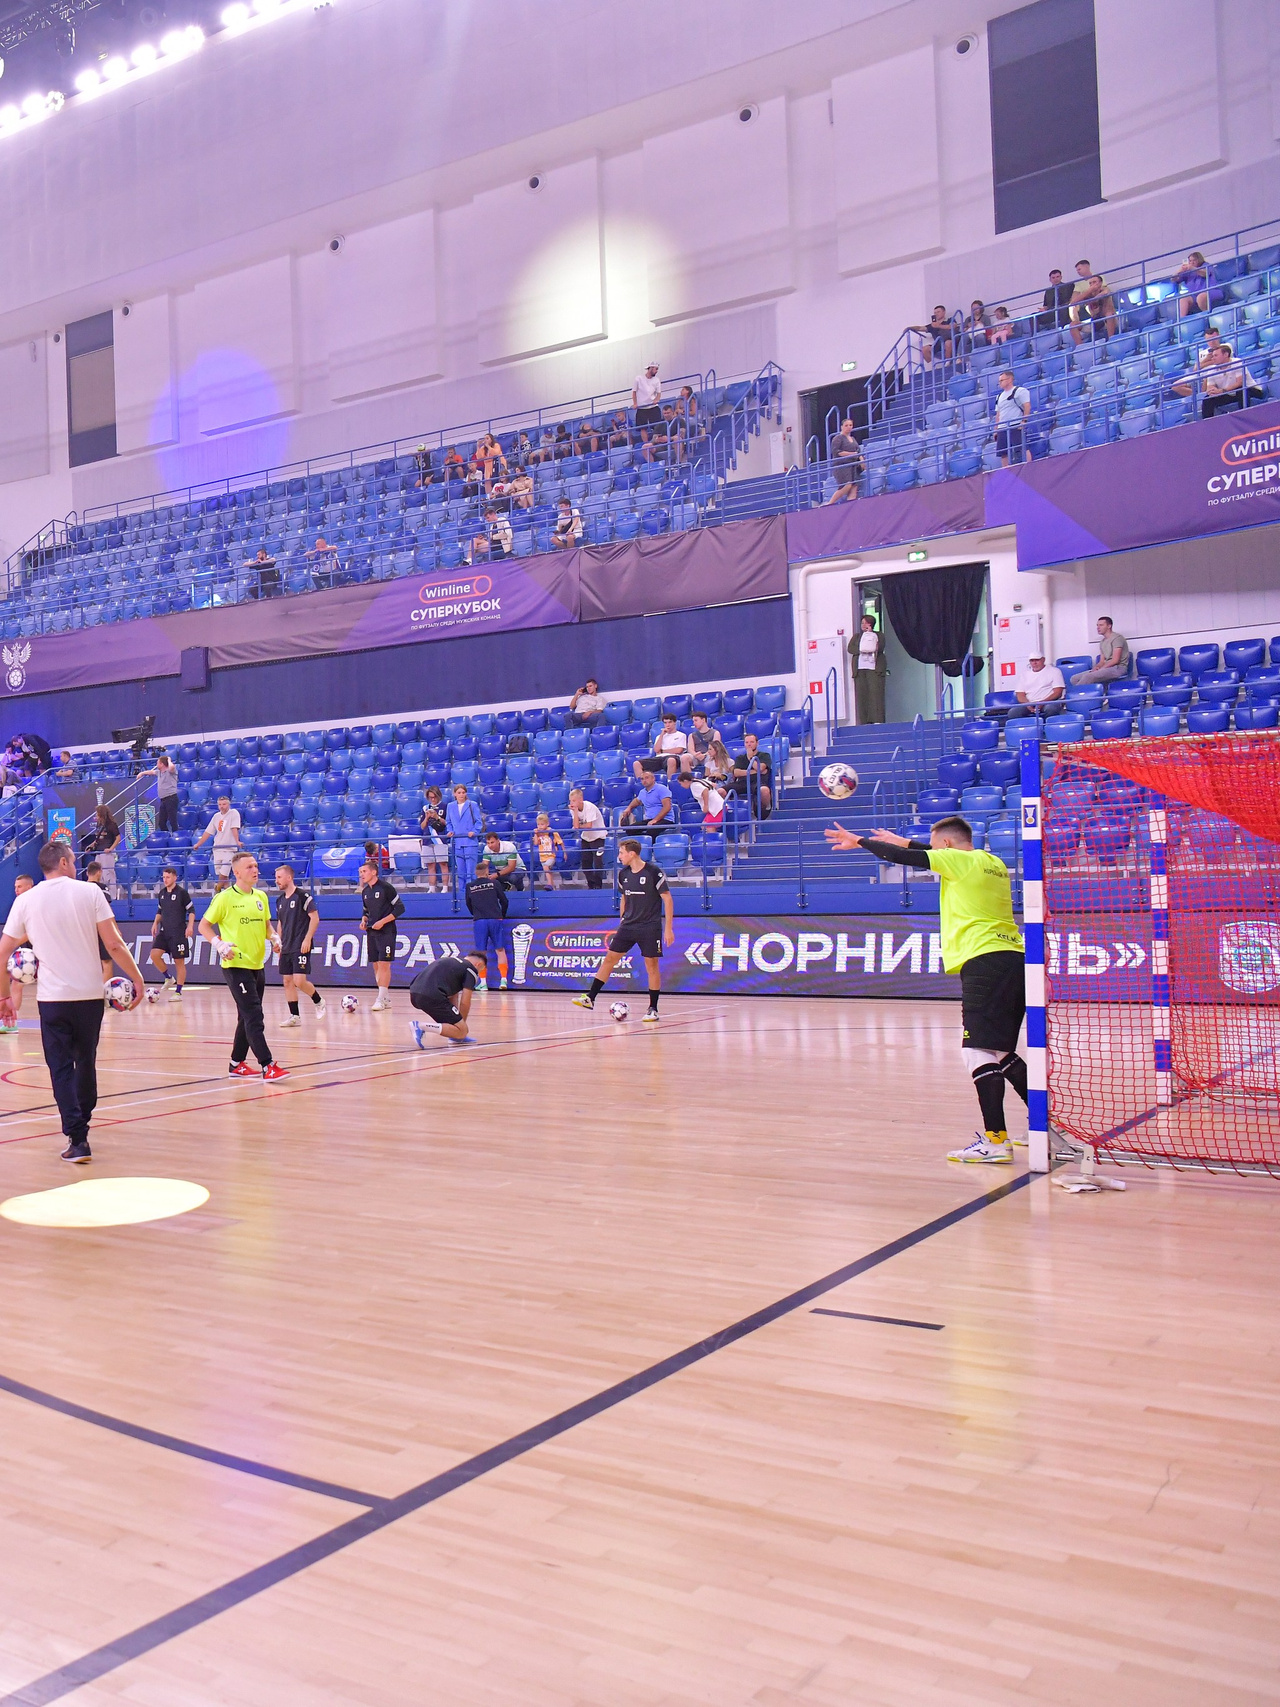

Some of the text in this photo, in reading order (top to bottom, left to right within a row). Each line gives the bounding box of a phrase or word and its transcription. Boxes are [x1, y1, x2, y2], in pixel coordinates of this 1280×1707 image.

[1207, 463, 1280, 493] СУПЕР
[1220, 491, 1255, 504] ФУТЗАЛУ
[425, 584, 471, 599] Winline
[410, 598, 501, 621] СУПЕРКУБОК
[552, 935, 602, 947] Winline
[177, 944, 185, 952] 18
[385, 946, 391, 954] 8
[297, 955, 308, 965] 19
[533, 955, 633, 968] СУПЕРКУК
[239, 982, 248, 994] 1
